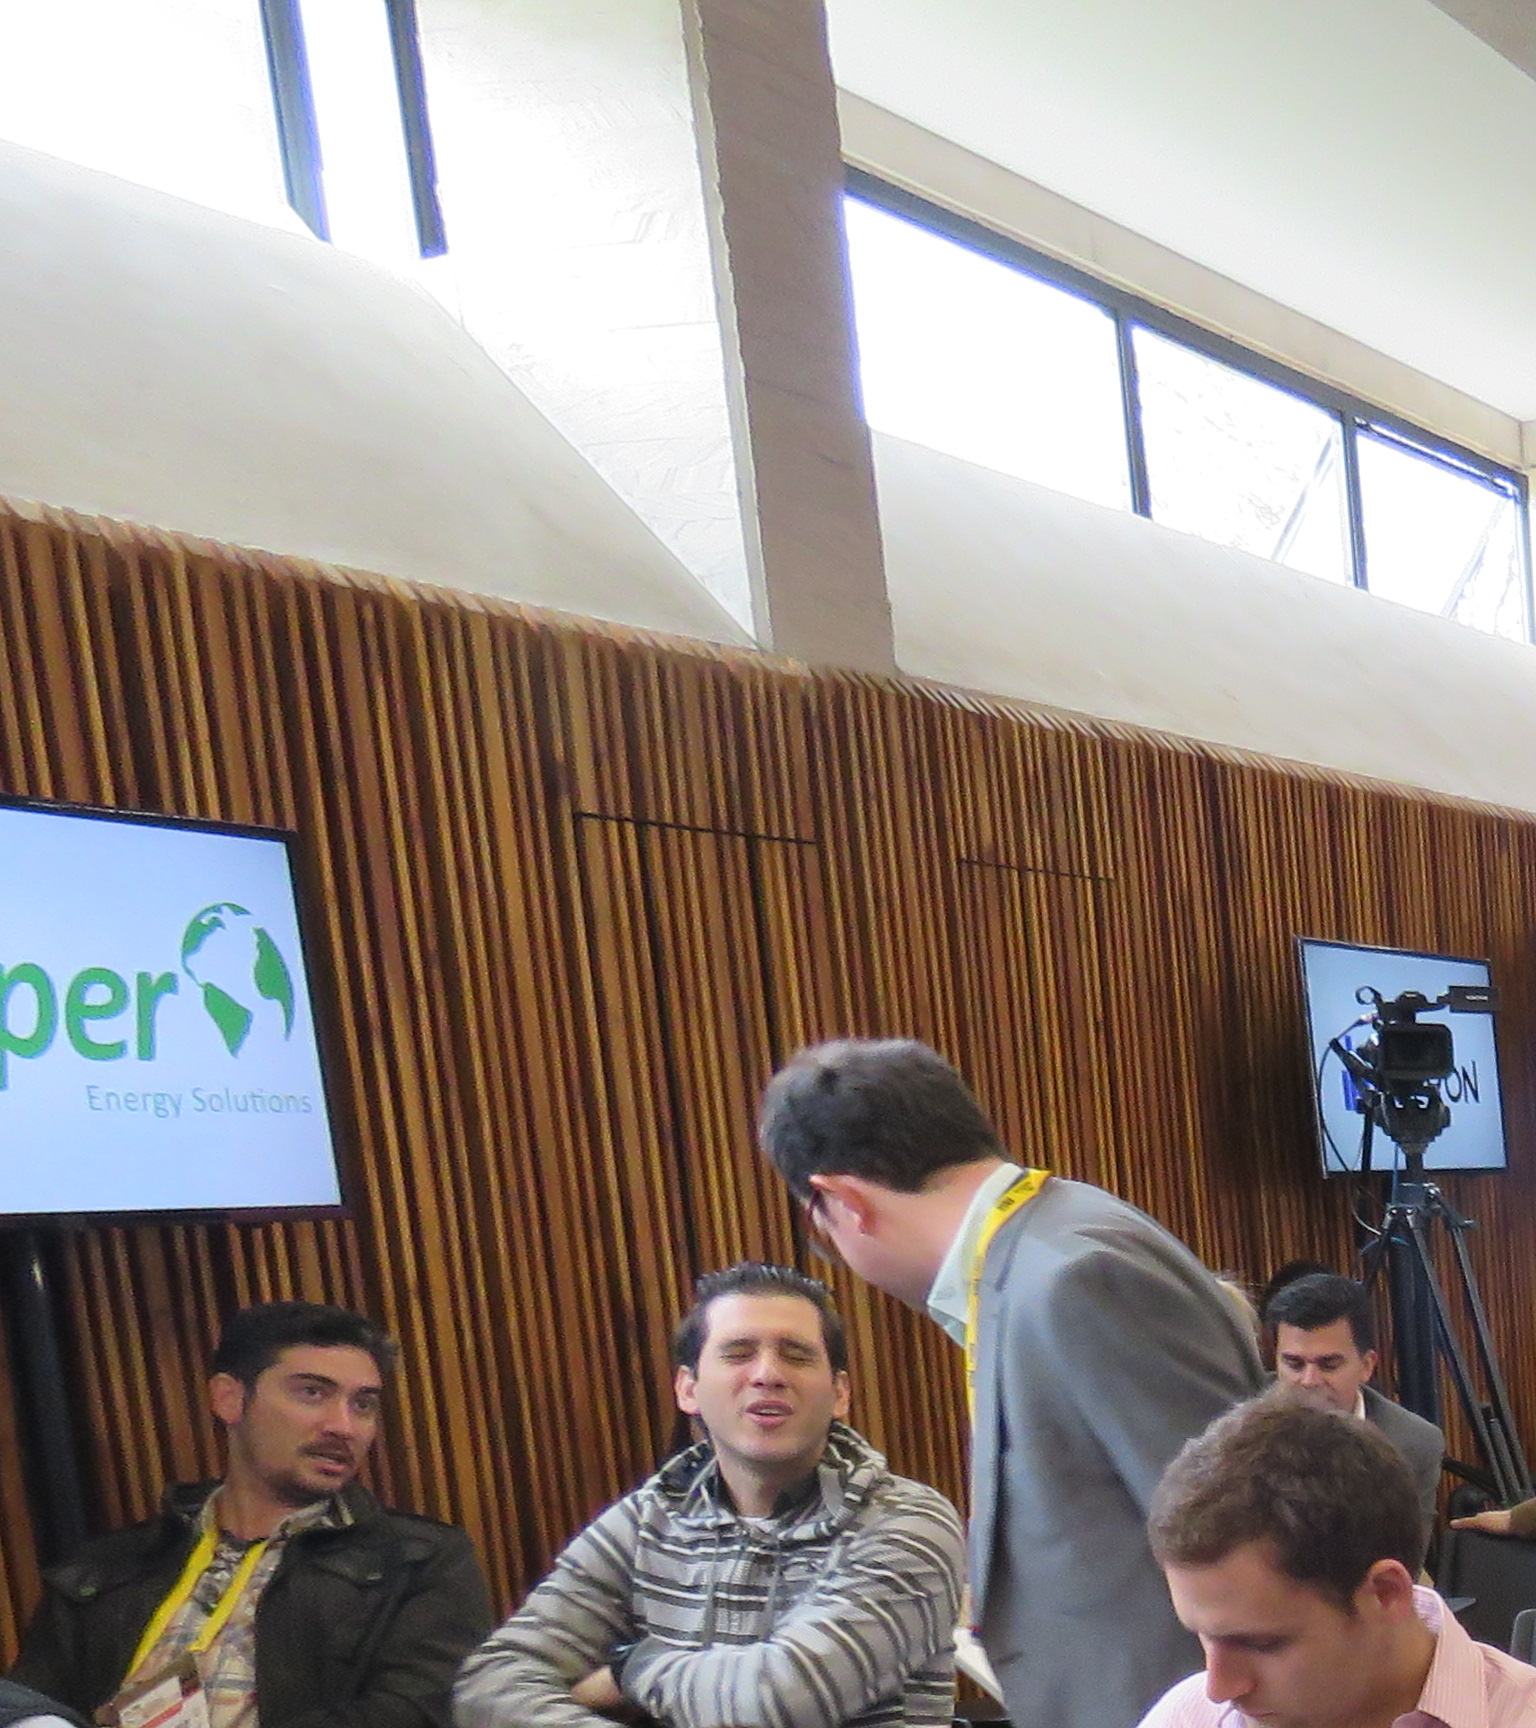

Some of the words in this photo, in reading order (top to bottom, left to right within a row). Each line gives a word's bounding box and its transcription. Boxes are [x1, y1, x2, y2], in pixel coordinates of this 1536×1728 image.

[0, 960, 179, 1091] per
[86, 1084, 183, 1118] Energy
[192, 1087, 313, 1115] Solutions
[1436, 1059, 1480, 1104] ON
